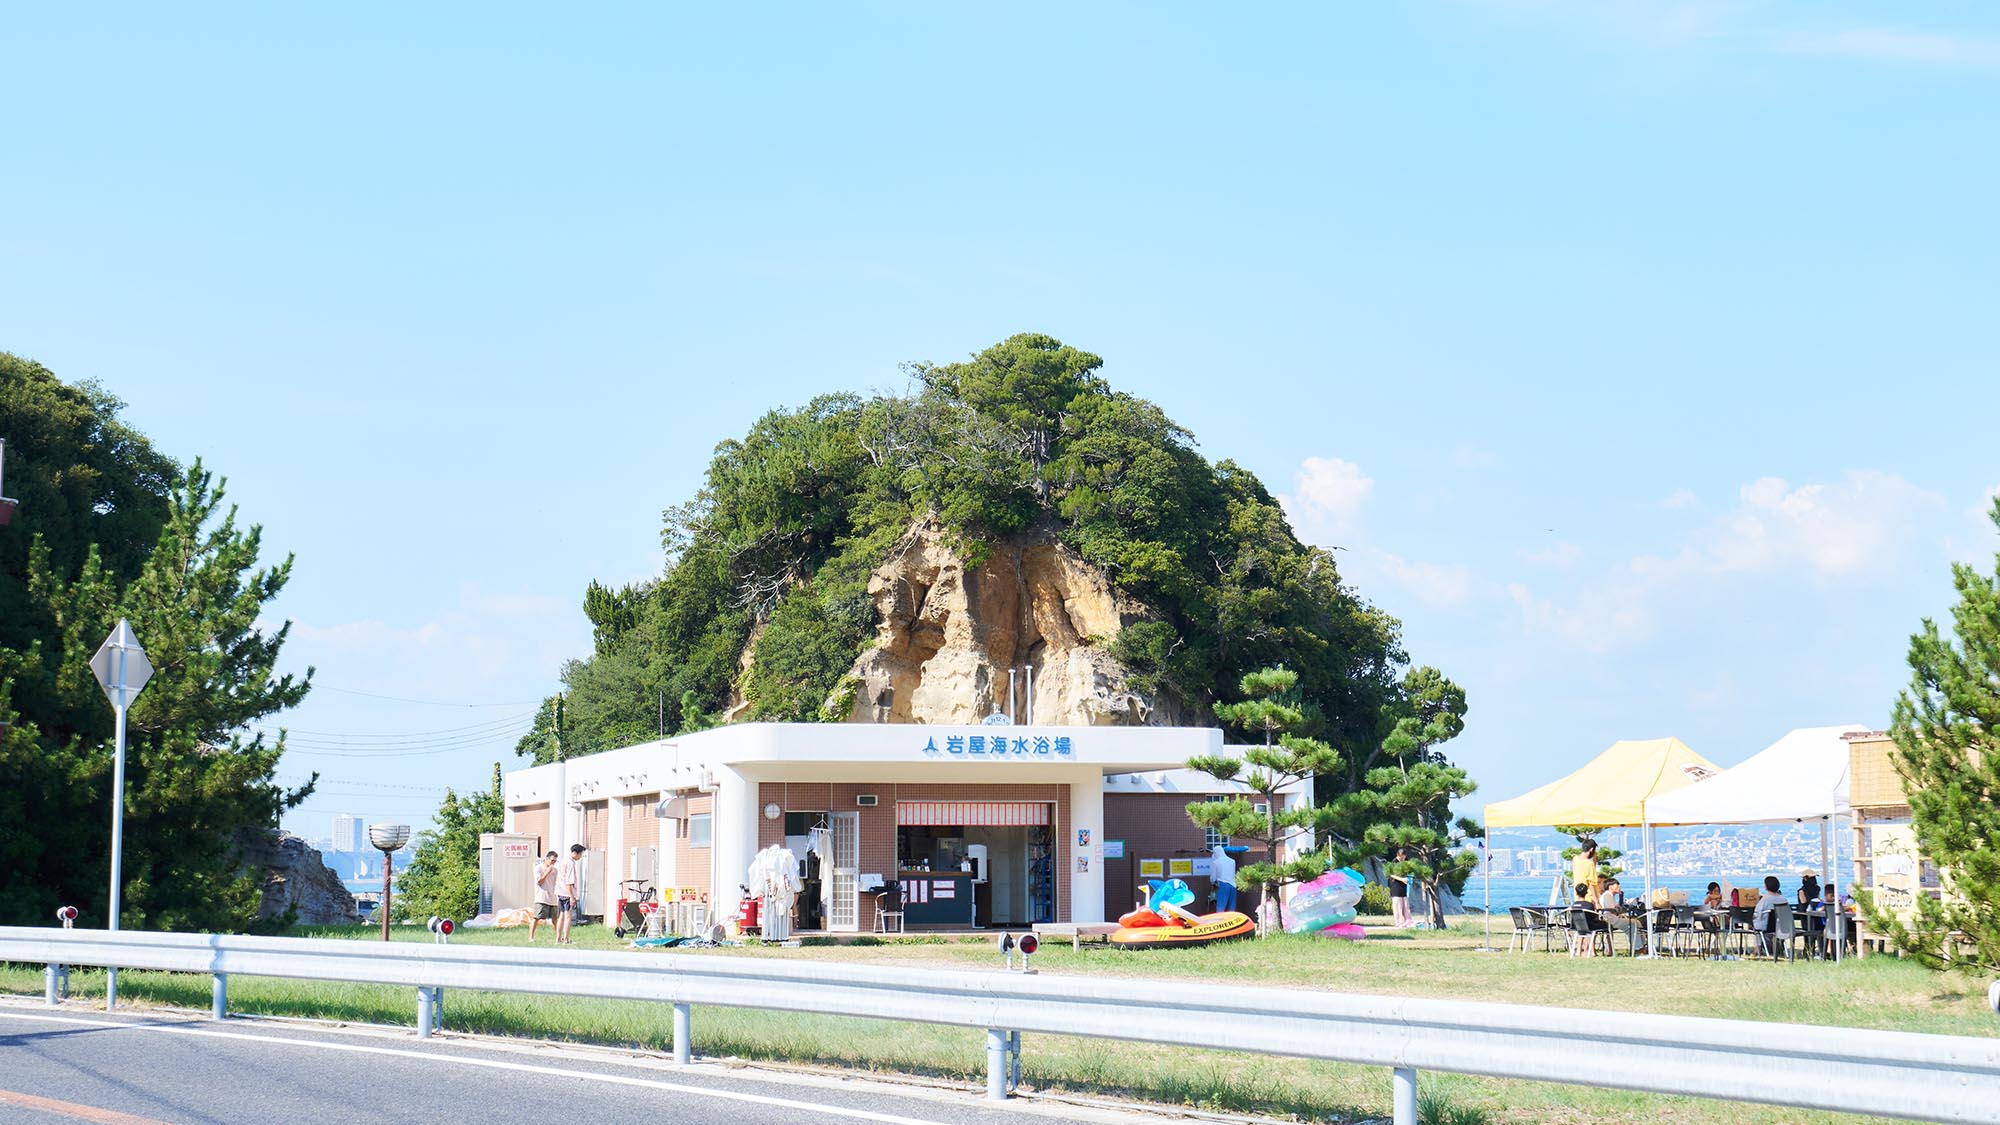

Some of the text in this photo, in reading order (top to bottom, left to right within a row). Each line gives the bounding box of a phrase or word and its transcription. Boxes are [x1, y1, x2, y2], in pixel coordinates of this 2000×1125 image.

[946, 735, 1071, 755] 岩屋海水浴場
[1194, 921, 1234, 934] EXPLORER
